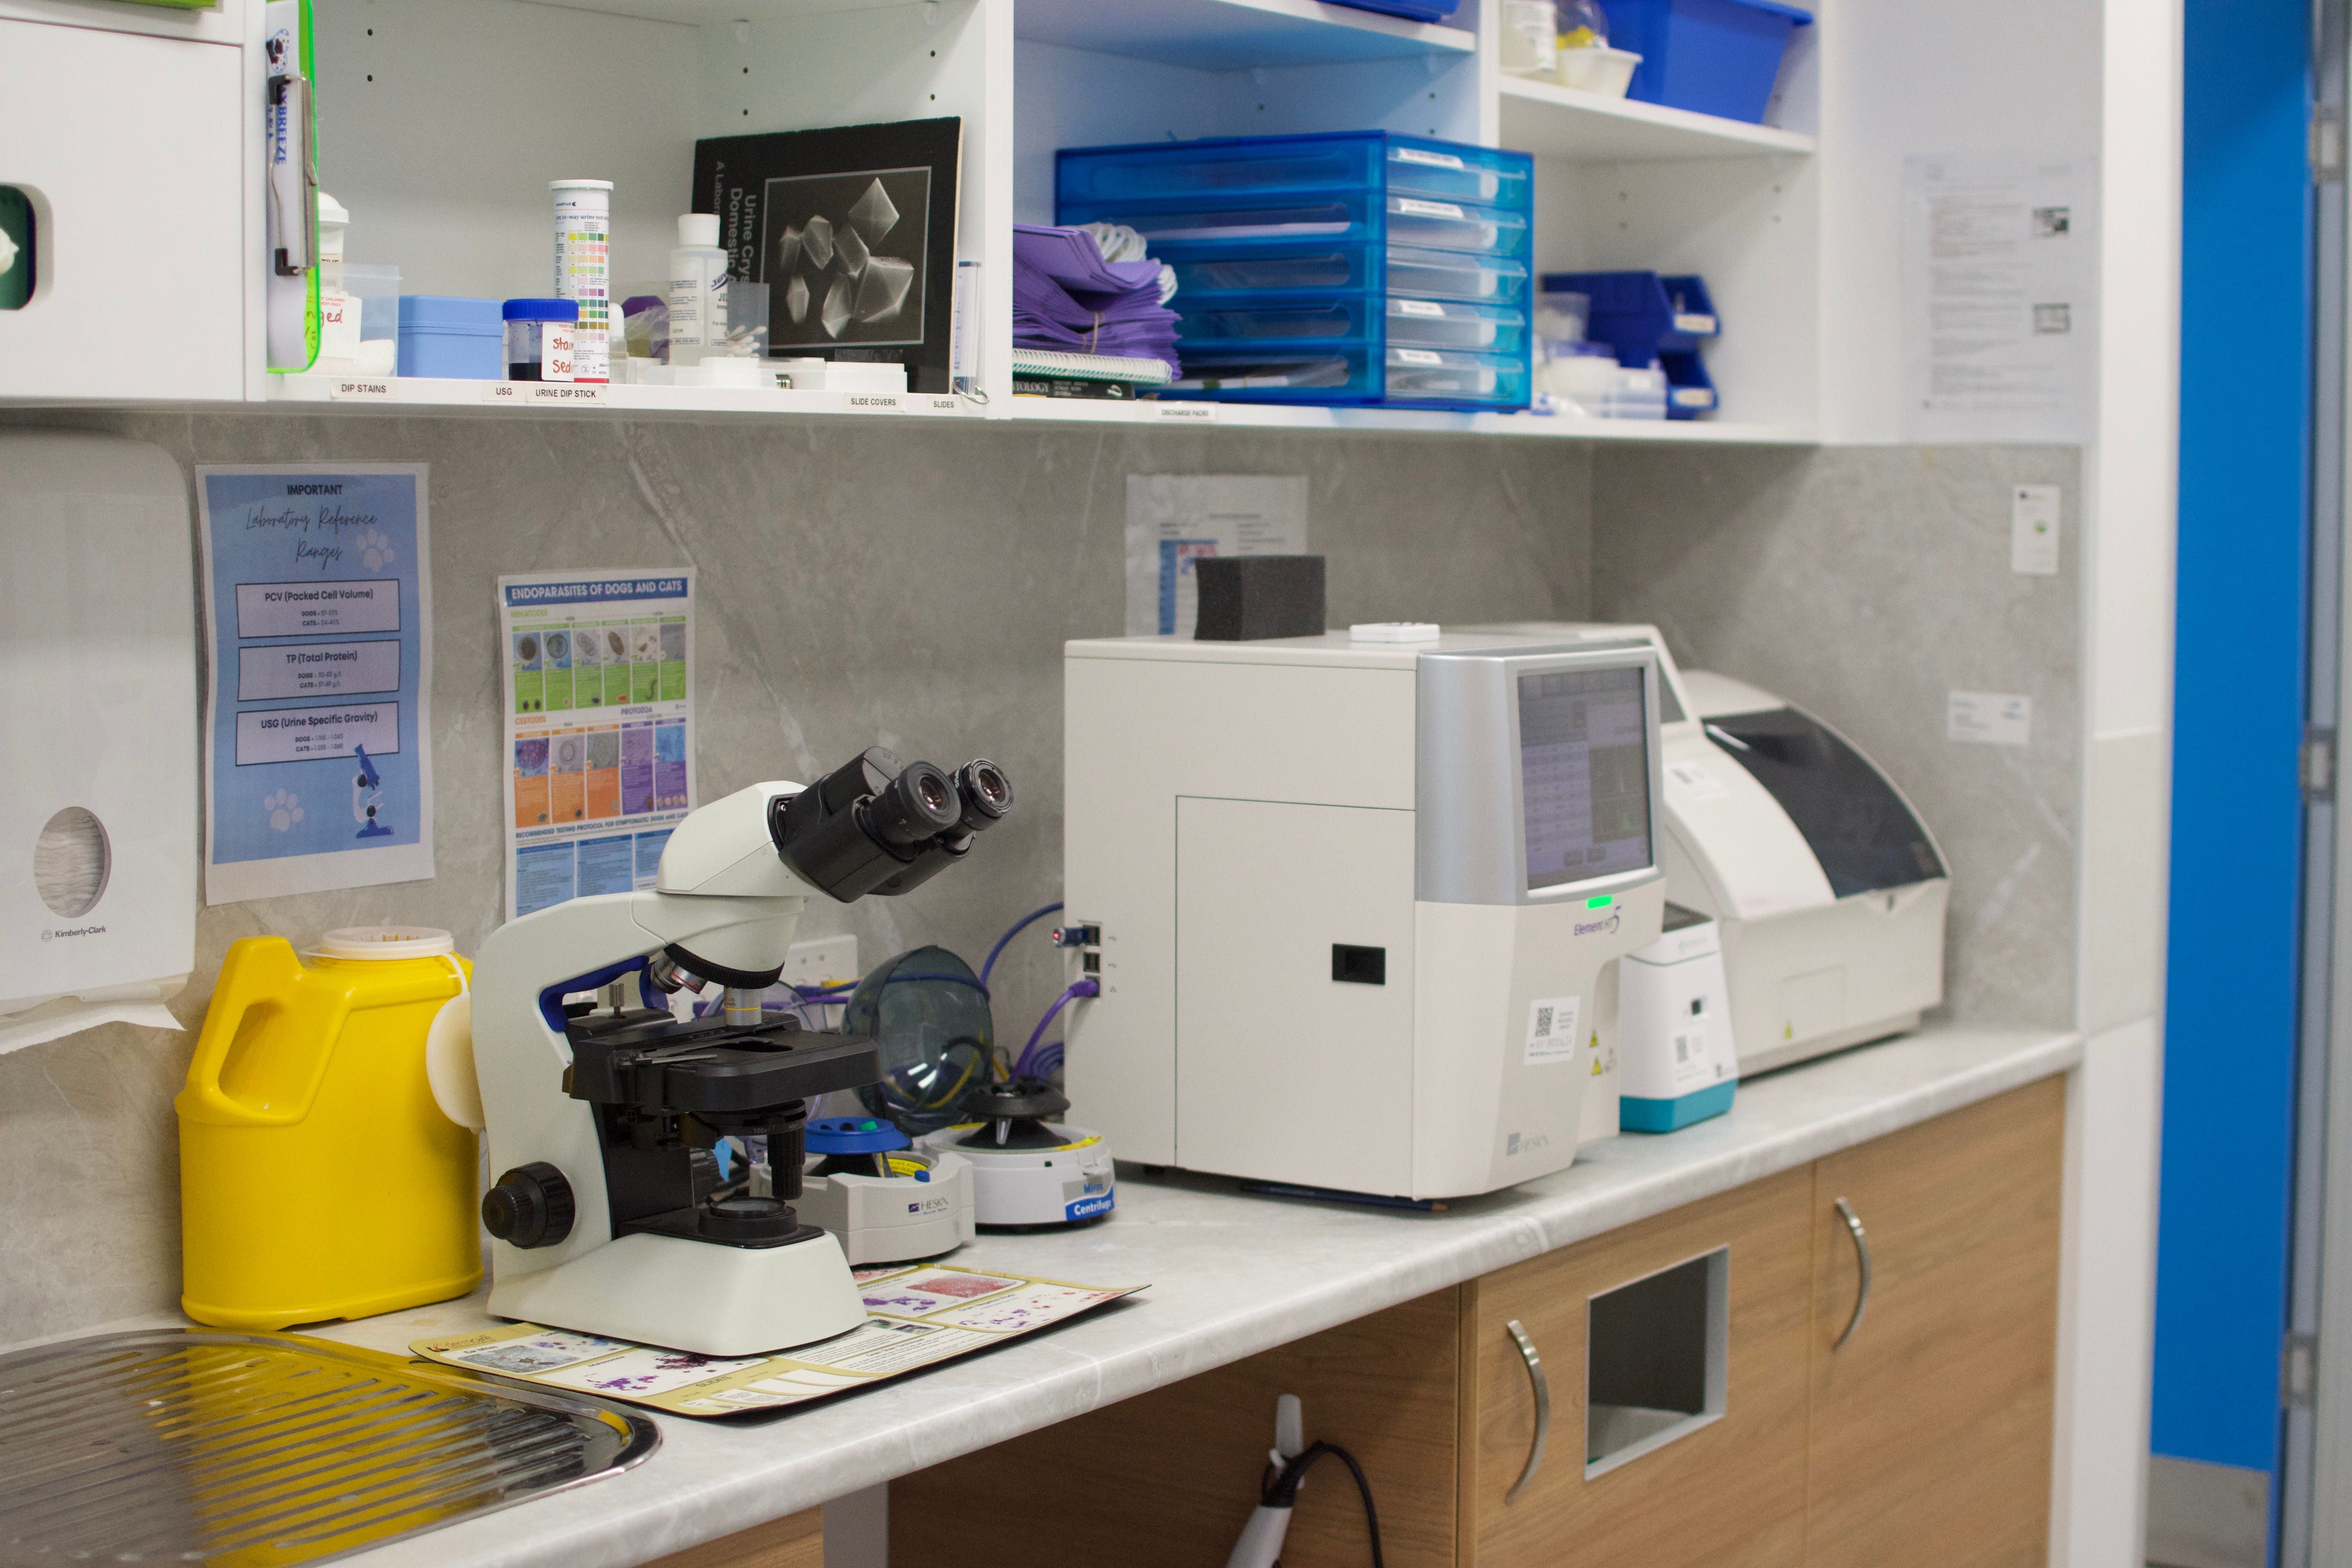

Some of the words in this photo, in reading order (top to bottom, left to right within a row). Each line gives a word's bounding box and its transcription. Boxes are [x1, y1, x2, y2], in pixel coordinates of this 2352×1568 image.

[716, 161, 725, 170] A
[743, 195, 757, 240] Urine
[728, 188, 742, 269] Domestic
[341, 384, 355, 392] DIP
[357, 384, 387, 393] STAINS
[535, 389, 558, 397] URINE
[287, 485, 343, 495] IMPORTANT
[245, 505, 310, 532] Laboratory
[318, 505, 378, 534] Reference
[296, 537, 343, 570] Ranges
[265, 592, 283, 601] PCV
[285, 590, 319, 602] (Packed
[321, 590, 338, 599] Cell
[339, 588, 373, 599] Volume)
[512, 584, 588, 599] ENDOPARASITES
[590, 584, 603, 595] OF
[605, 582, 633, 595] DOGS
[636, 581, 656, 593] AND
[659, 580, 682, 592] CATS
[287, 654, 296, 663] TP
[298, 652, 323, 664] (Total
[325, 650, 357, 661] Protein)
[261, 720, 279, 728] USG
[281, 717, 306, 729] (Urine
[308, 715, 342, 727] Specific
[344, 711, 377, 723] Gravity)
[516, 828, 555, 838] RECOMMENDED
[577, 822, 604, 830] PROTOCOL
[55, 926, 106, 937] Kimberly-Clark
[1574, 920, 1604, 936] Element
[920, 1197, 948, 1211] HESKA
[695, 1376, 732, 1387] SLIDES
